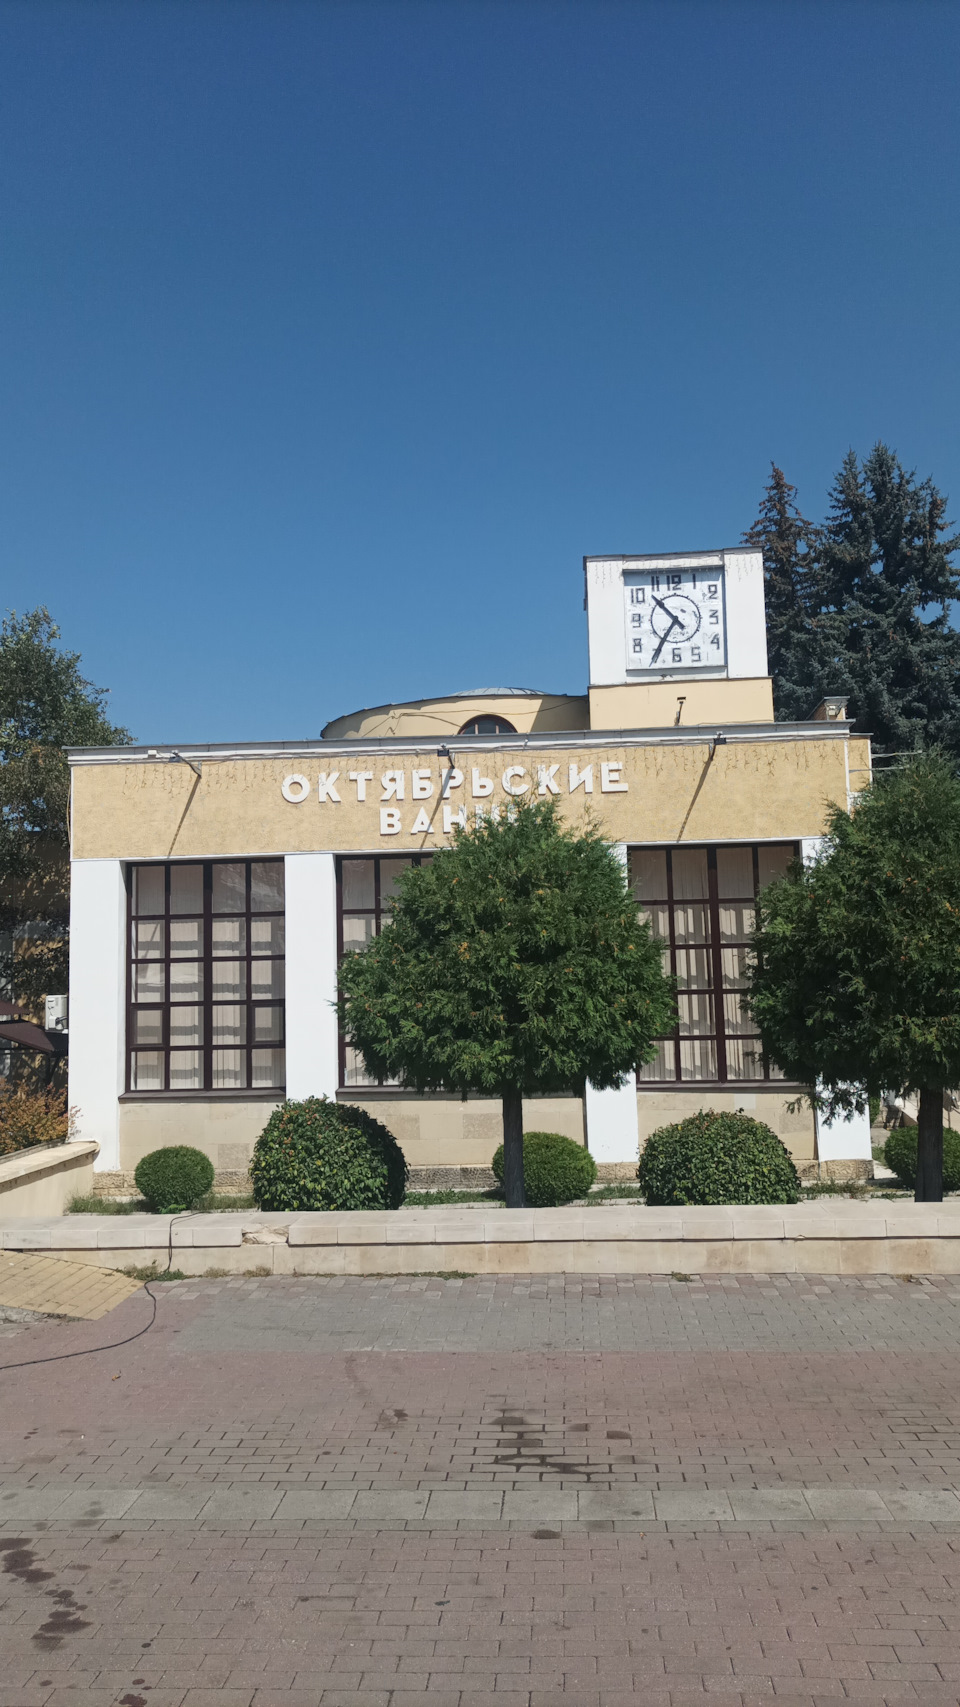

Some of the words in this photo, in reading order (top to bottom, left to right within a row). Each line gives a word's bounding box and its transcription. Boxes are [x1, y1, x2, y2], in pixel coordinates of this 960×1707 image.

[651, 576, 660, 592] 11
[666, 574, 682, 591] 12
[692, 574, 696, 589] 1
[631, 587, 645, 604] 10
[708, 584, 718, 599] 2
[632, 613, 641, 628] 9
[709, 609, 719, 625] 3
[633, 638, 642, 653] 8
[711, 633, 720, 650] 4
[672, 647, 682, 663] 6
[691, 646, 701, 662] 5
[281, 761, 629, 804] ОКТЯБРЬСКИЕ
